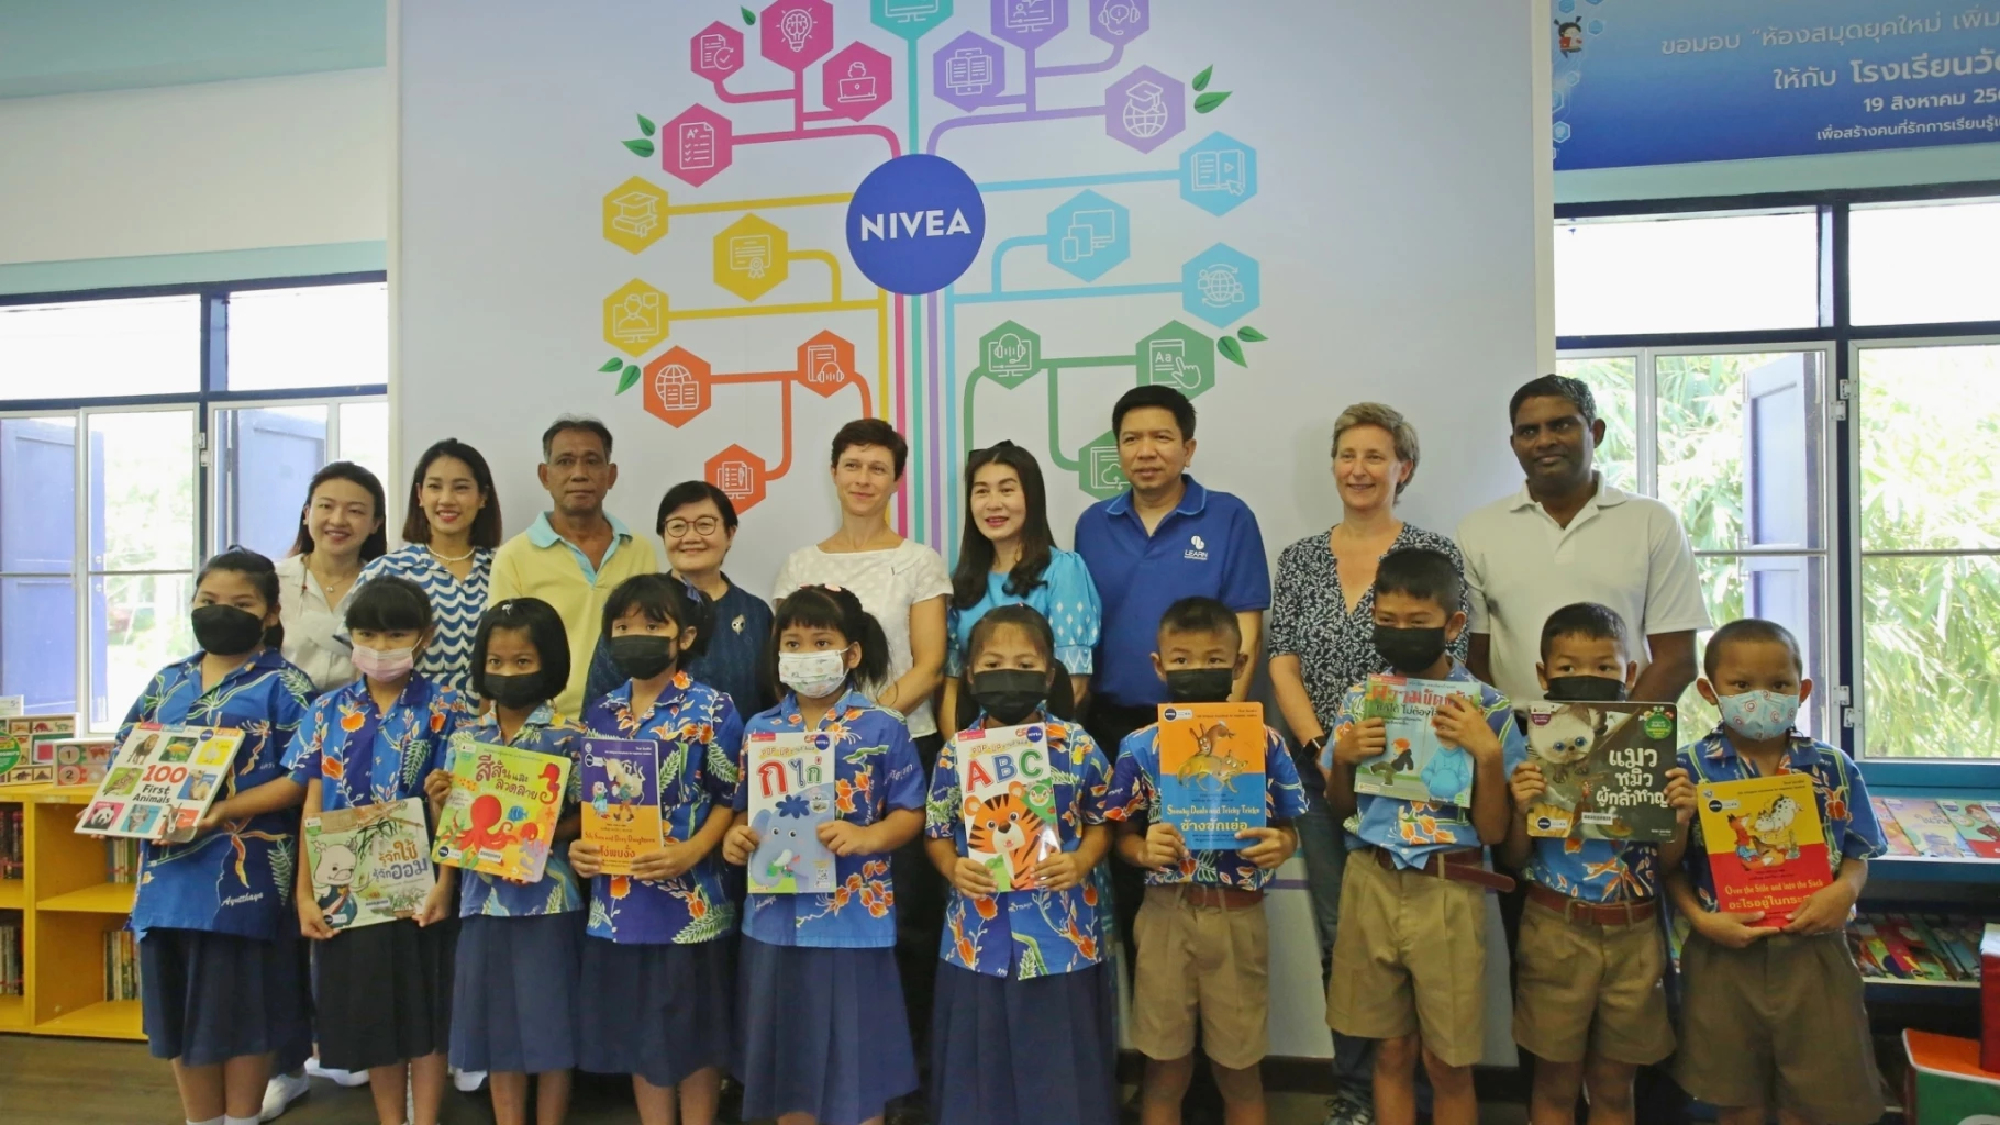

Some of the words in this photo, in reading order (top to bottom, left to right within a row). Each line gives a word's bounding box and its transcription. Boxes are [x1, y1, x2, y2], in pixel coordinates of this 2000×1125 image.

[1662, 34, 1741, 55] ขอมอบ
[1773, 66, 1837, 90] ให้กับ
[1863, 97, 1884, 112] 19
[1890, 93, 1966, 111] สิงหาคม
[1973, 88, 2000, 104] 25
[862, 208, 971, 241] NIVEA
[1155, 352, 1171, 363] Aa
[1609, 748, 1658, 769] แมว
[142, 765, 187, 783] 100
[133, 793, 171, 804] Animals
[142, 784, 171, 794] First
